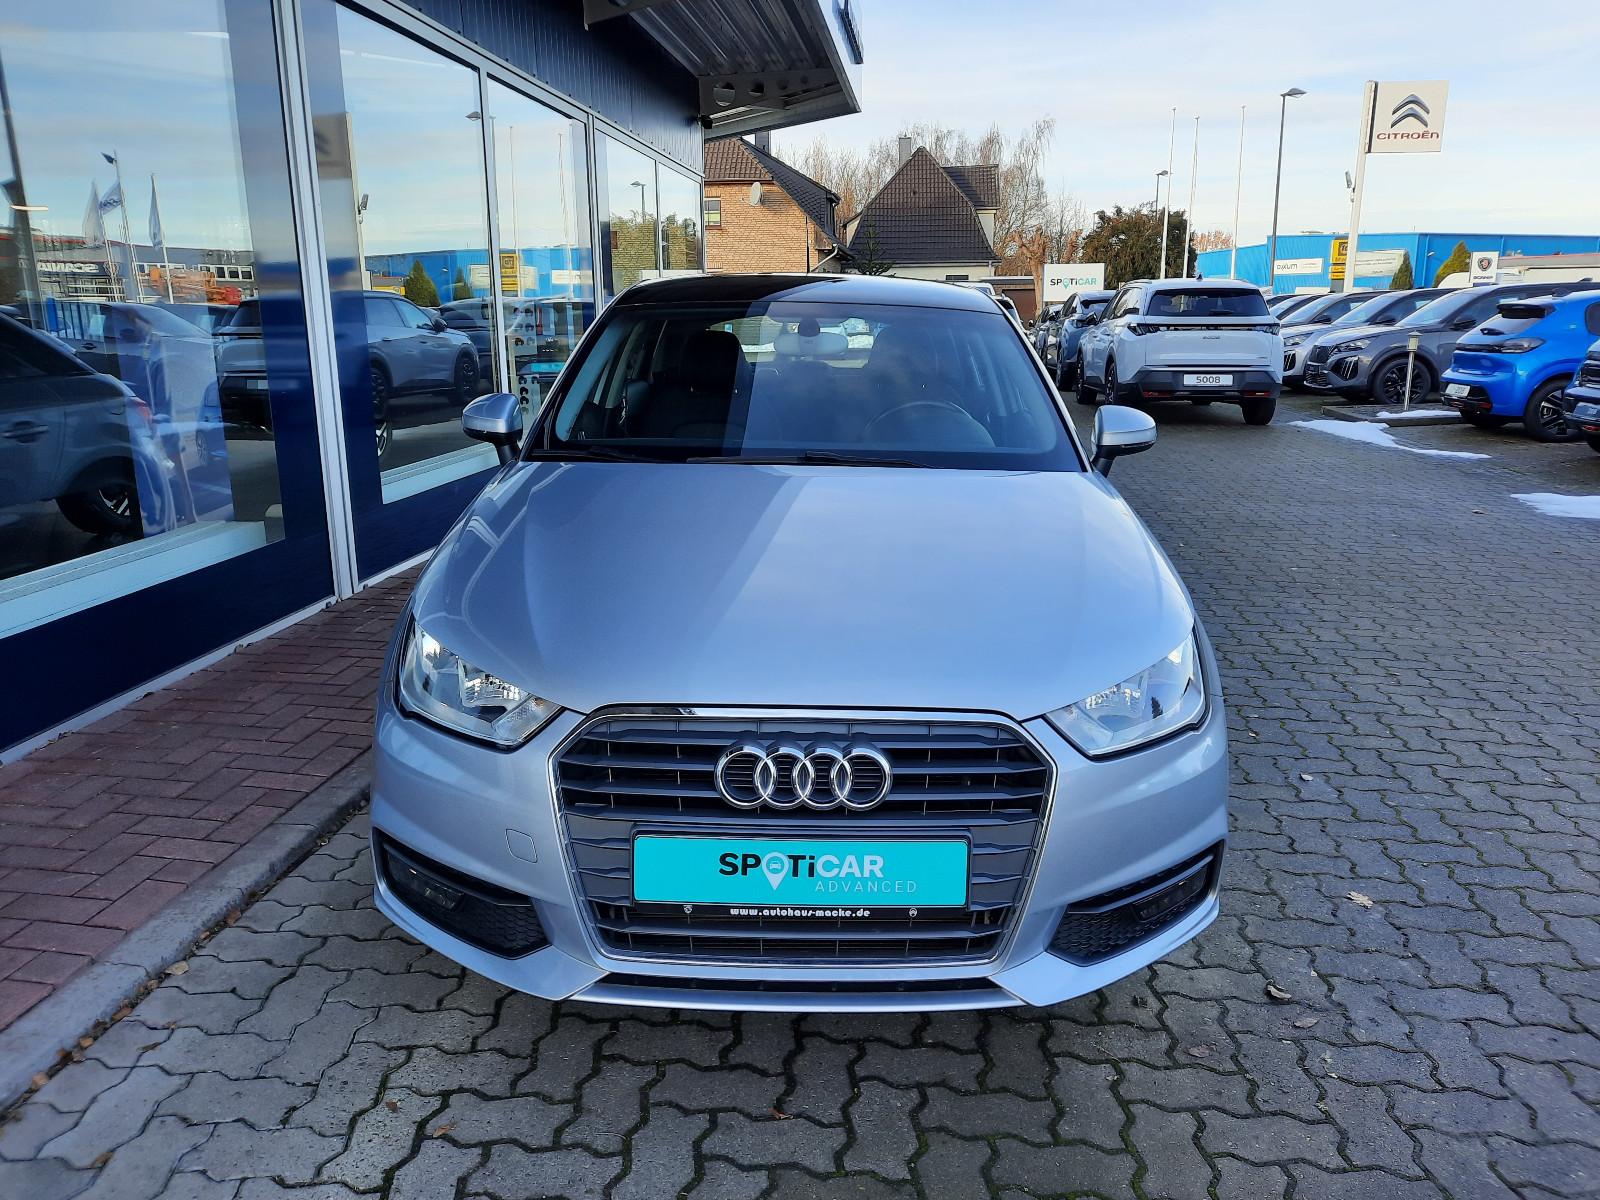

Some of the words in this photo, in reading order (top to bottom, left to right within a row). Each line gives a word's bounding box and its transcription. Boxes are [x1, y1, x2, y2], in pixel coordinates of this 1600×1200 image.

[1196, 376, 1221, 384] 5008
[814, 880, 917, 893] ADVANCED
[729, 907, 871, 918] www.autohaus-macke.de
